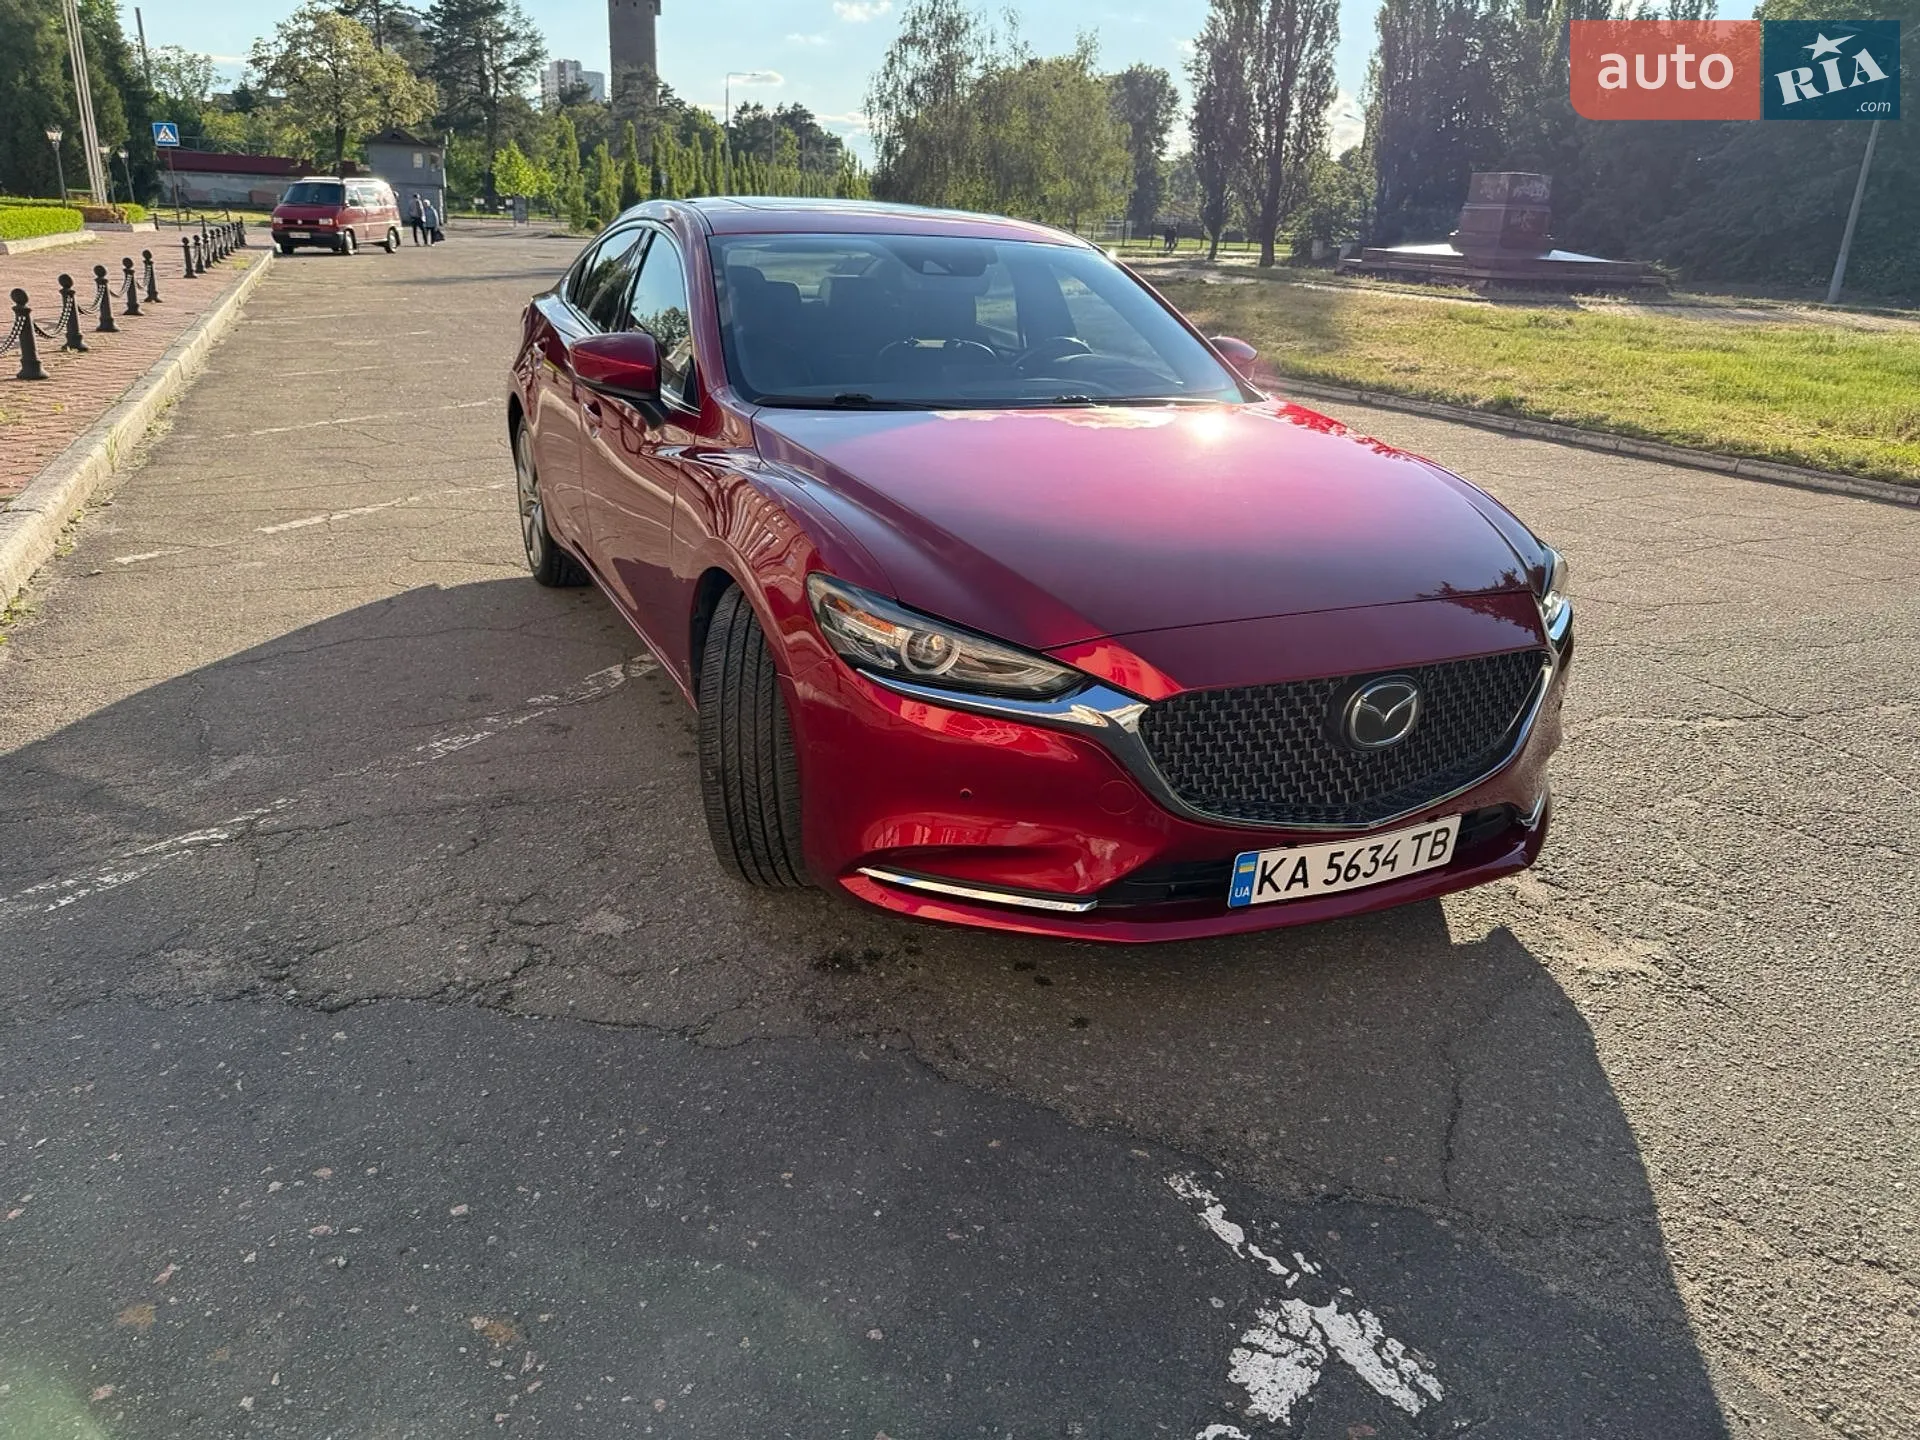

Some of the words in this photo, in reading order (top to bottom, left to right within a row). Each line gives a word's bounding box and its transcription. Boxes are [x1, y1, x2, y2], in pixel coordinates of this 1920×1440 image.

[1256, 856, 1310, 896] KA
[1322, 839, 1402, 887] 5634
[1410, 826, 1450, 867] TB
[1234, 888, 1250, 899] UA
